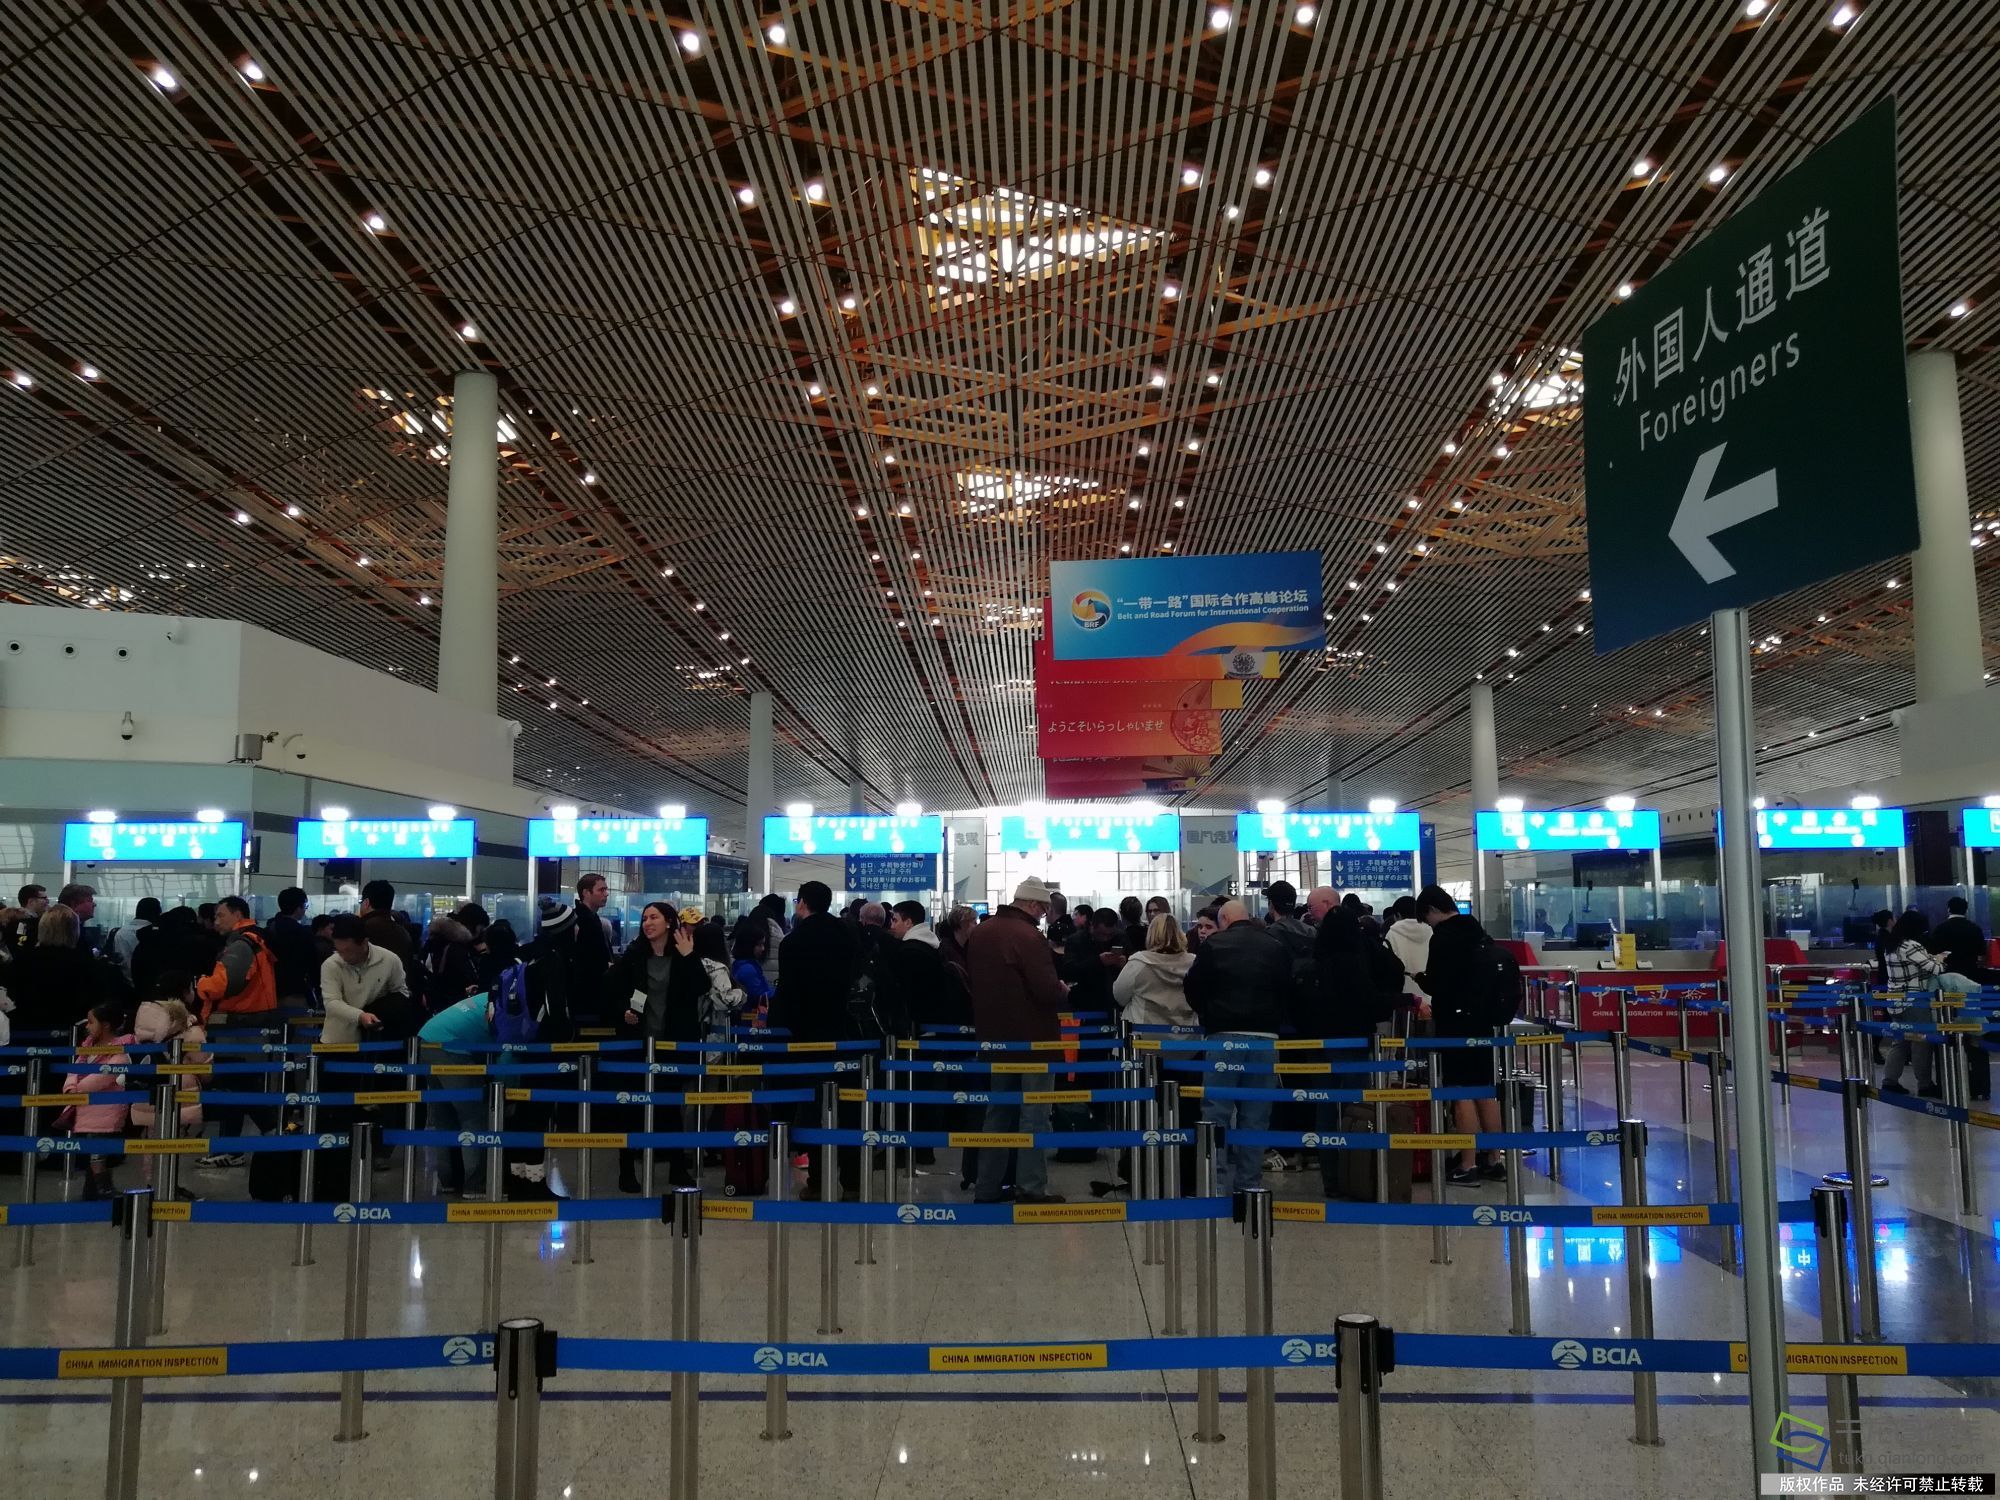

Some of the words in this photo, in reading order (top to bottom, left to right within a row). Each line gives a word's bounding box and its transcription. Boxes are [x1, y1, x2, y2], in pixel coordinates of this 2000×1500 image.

[1613, 206, 1831, 408] 外国人通道
[1639, 329, 1801, 451] Foreigners
[1117, 612, 1133, 620] Belt
[1134, 611, 1149, 619] and
[1150, 611, 1170, 619] Road
[1171, 610, 1196, 618] Forum
[1197, 609, 1209, 617] for
[1209, 606, 1261, 615] International
[1262, 605, 1309, 615] Cooperation
[1048, 719, 1165, 733] ようこそいらっしゃいませ
[1666, 1010, 1709, 1018] INSCTION
[301, 1095, 321, 1103] BCIA
[632, 1094, 651, 1102] BCIA
[969, 1094, 989, 1102] BCIA
[1308, 1092, 1329, 1100] BCIA
[477, 1135, 501, 1144] BCIA
[753, 1134, 768, 1143] BC
[882, 1135, 906, 1144] BCIA
[1162, 1133, 1188, 1142] BCIA
[1322, 1136, 1347, 1146] BCIA
[1606, 1133, 1621, 1142] BC
[57, 1141, 81, 1151] BCIA
[152, 1207, 186, 1216] NSPECTION
[360, 1207, 391, 1220] BCIA
[924, 1208, 956, 1221] BCIA
[1040, 1209, 1083, 1217] IMMIGRATION
[1084, 1208, 1121, 1216] INSPECTION
[1282, 1206, 1320, 1216] INSPECTION
[1597, 1212, 1617, 1220] CHINA
[1619, 1212, 1664, 1220] IMMIGRATION
[1664, 1211, 1704, 1219] INSPECTION
[1500, 1210, 1533, 1223] BCIA
[1315, 1343, 1336, 1358] BC
[787, 1352, 828, 1367] BCIA
[942, 1355, 969, 1364] CHINA
[973, 1354, 1035, 1363] IMMIGRATION
[1039, 1353, 1092, 1362] INSPECTION
[1592, 1347, 1642, 1365] BCIA
[1786, 1354, 1838, 1365] MIGRATION
[1840, 1355, 1898, 1366] INSPECTION
[65, 1360, 94, 1371] CHINA
[98, 1359, 164, 1370] IMMIGRATION
[164, 1357, 219, 1368] INSPECTION
